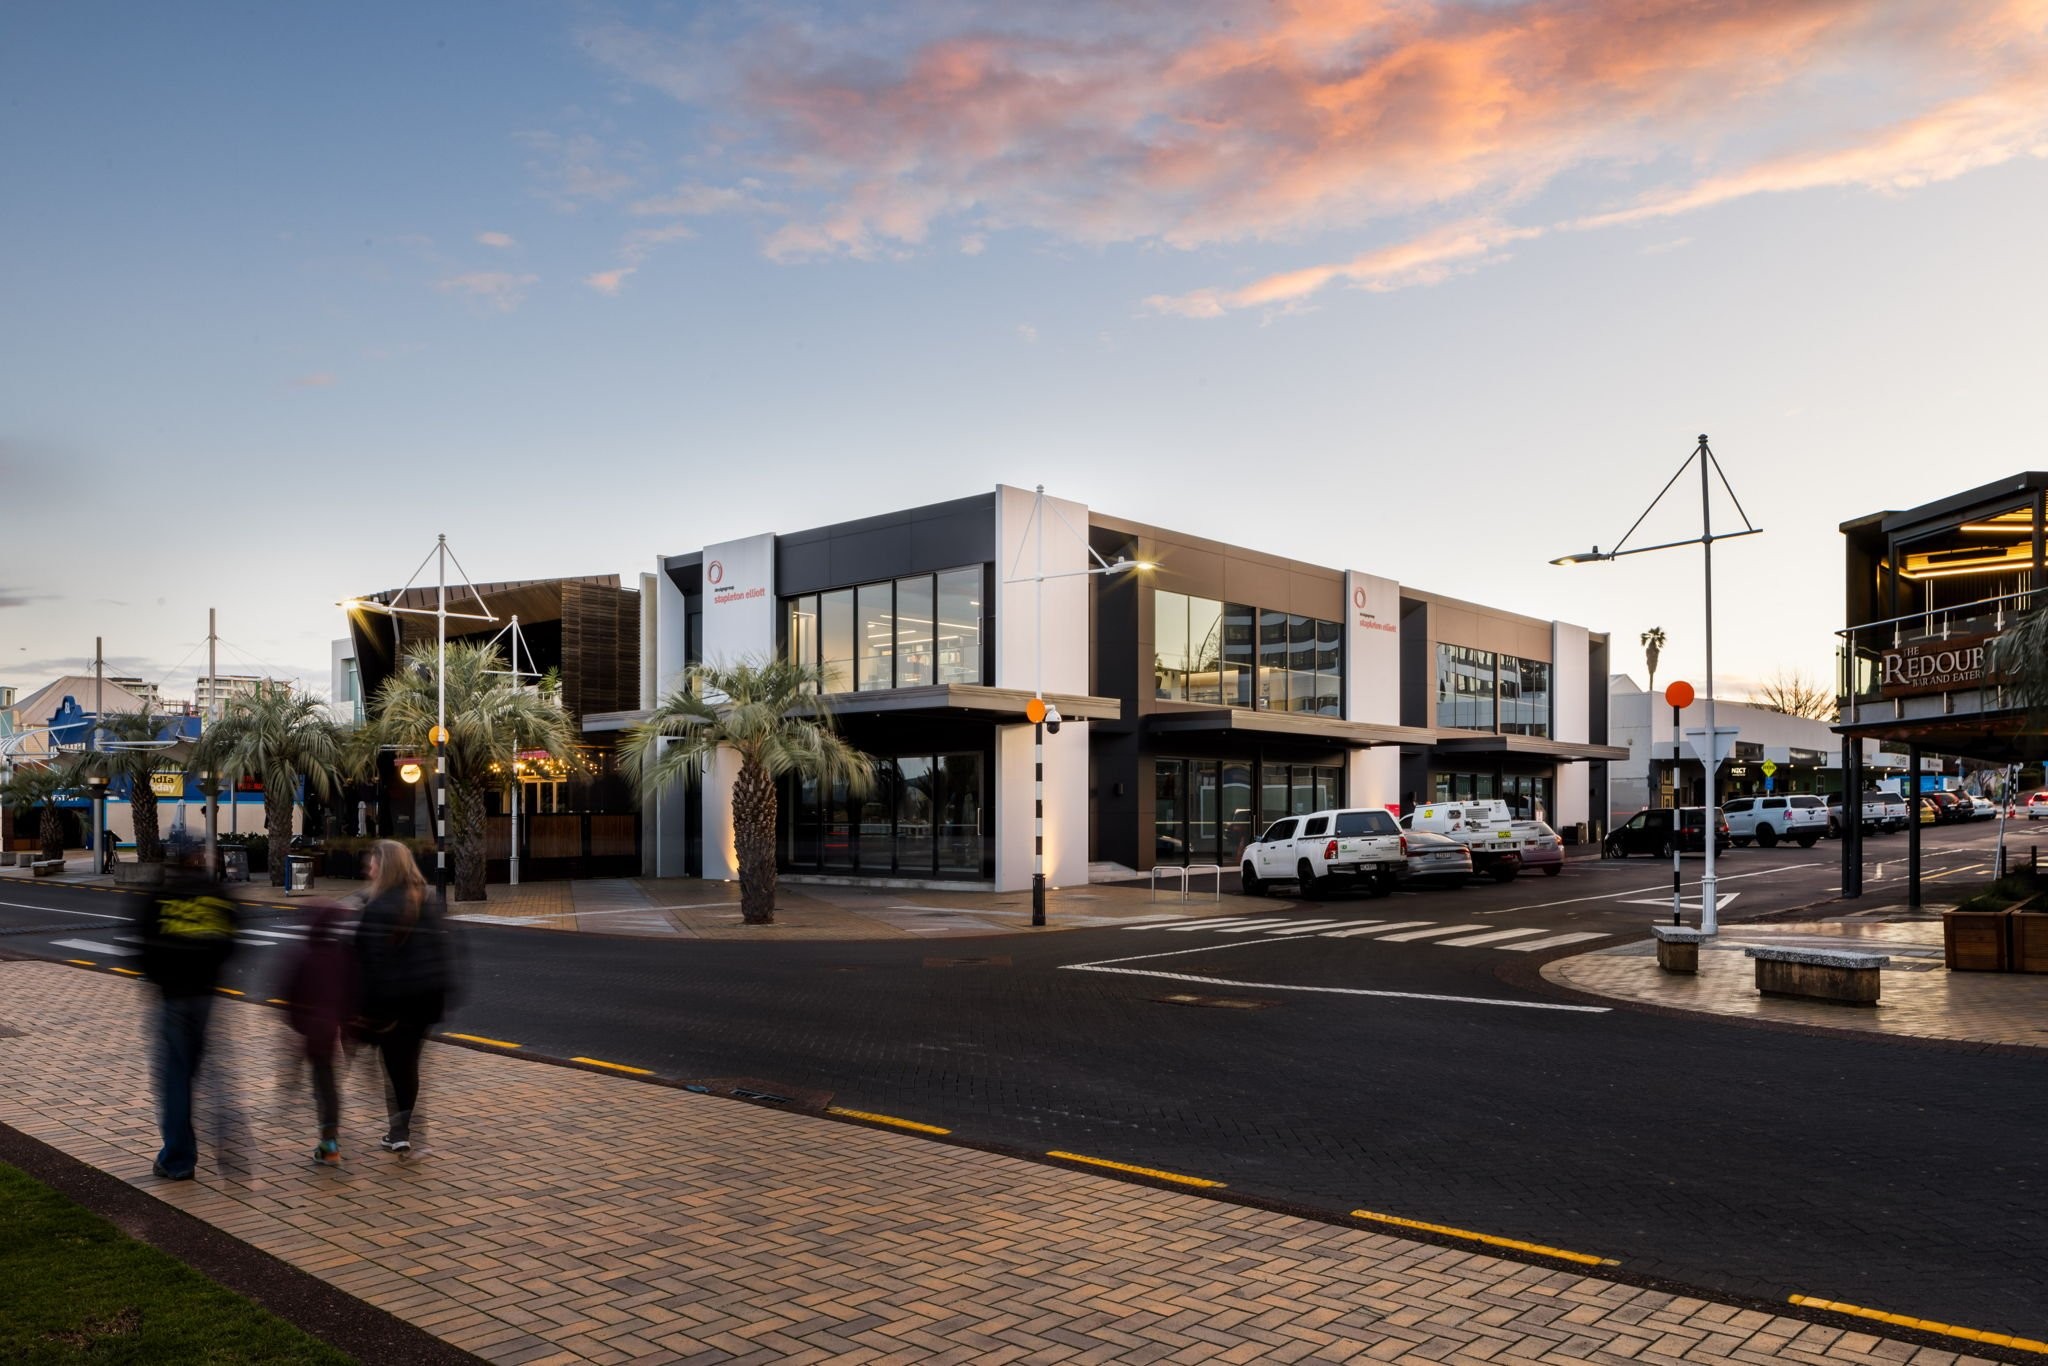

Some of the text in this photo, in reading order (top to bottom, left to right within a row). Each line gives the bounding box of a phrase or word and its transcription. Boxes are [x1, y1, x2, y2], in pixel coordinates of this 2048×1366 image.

[714, 587, 765, 604] stapleton elliott
[1903, 646, 1919, 657] THE
[1912, 677, 1928, 688] BAR
[1929, 674, 1950, 686] AND
[151, 783, 176, 793] oday
